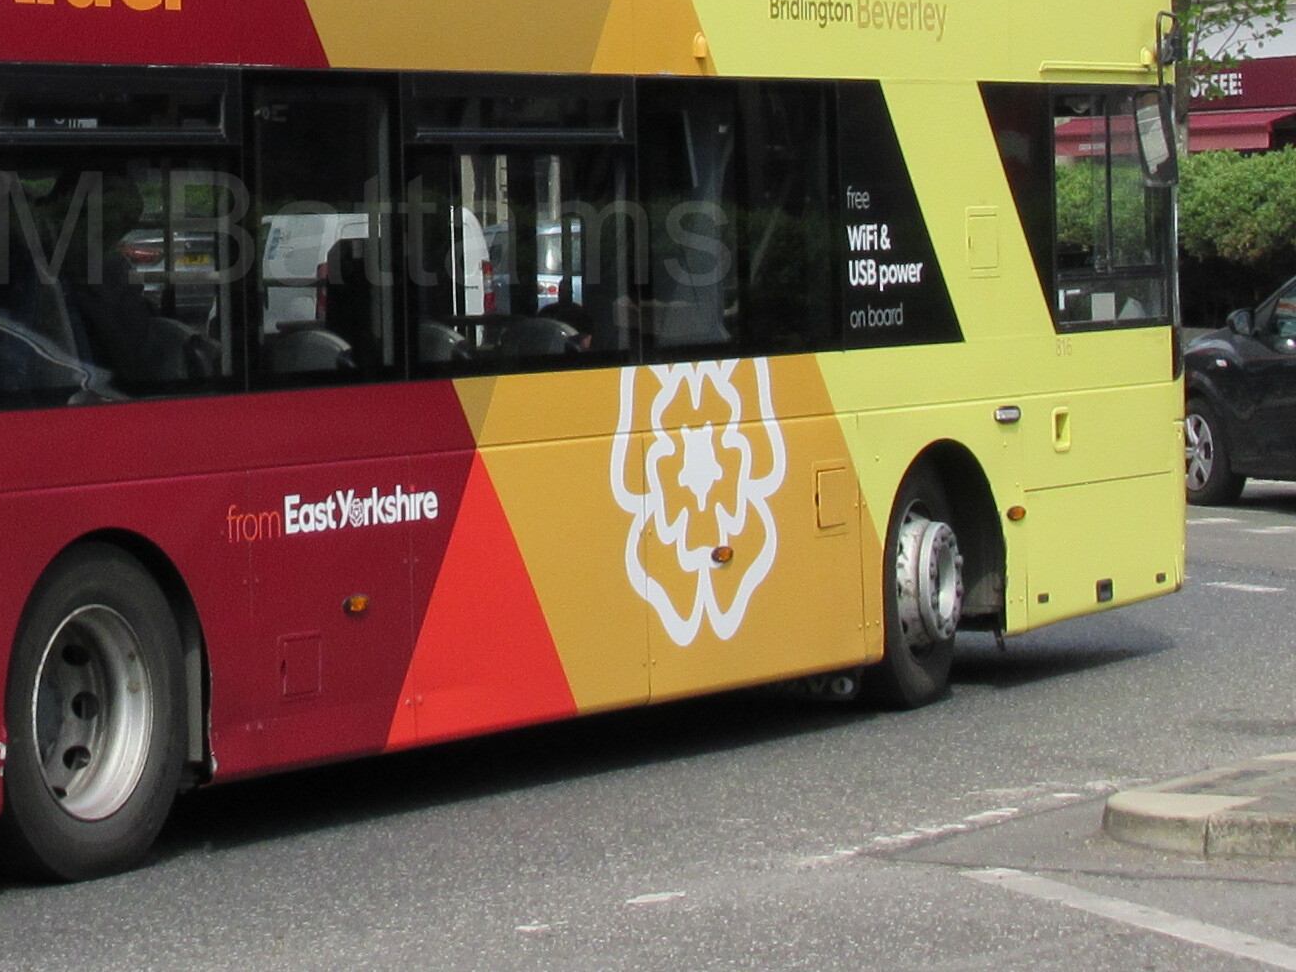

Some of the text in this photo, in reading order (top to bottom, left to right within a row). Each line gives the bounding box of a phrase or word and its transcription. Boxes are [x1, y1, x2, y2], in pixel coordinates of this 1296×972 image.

[846, 185, 871, 210] free
[846, 223, 892, 251] WiFi &
[848, 258, 924, 292] USB power
[849, 302, 904, 328] on board
[226, 504, 281, 543] from
